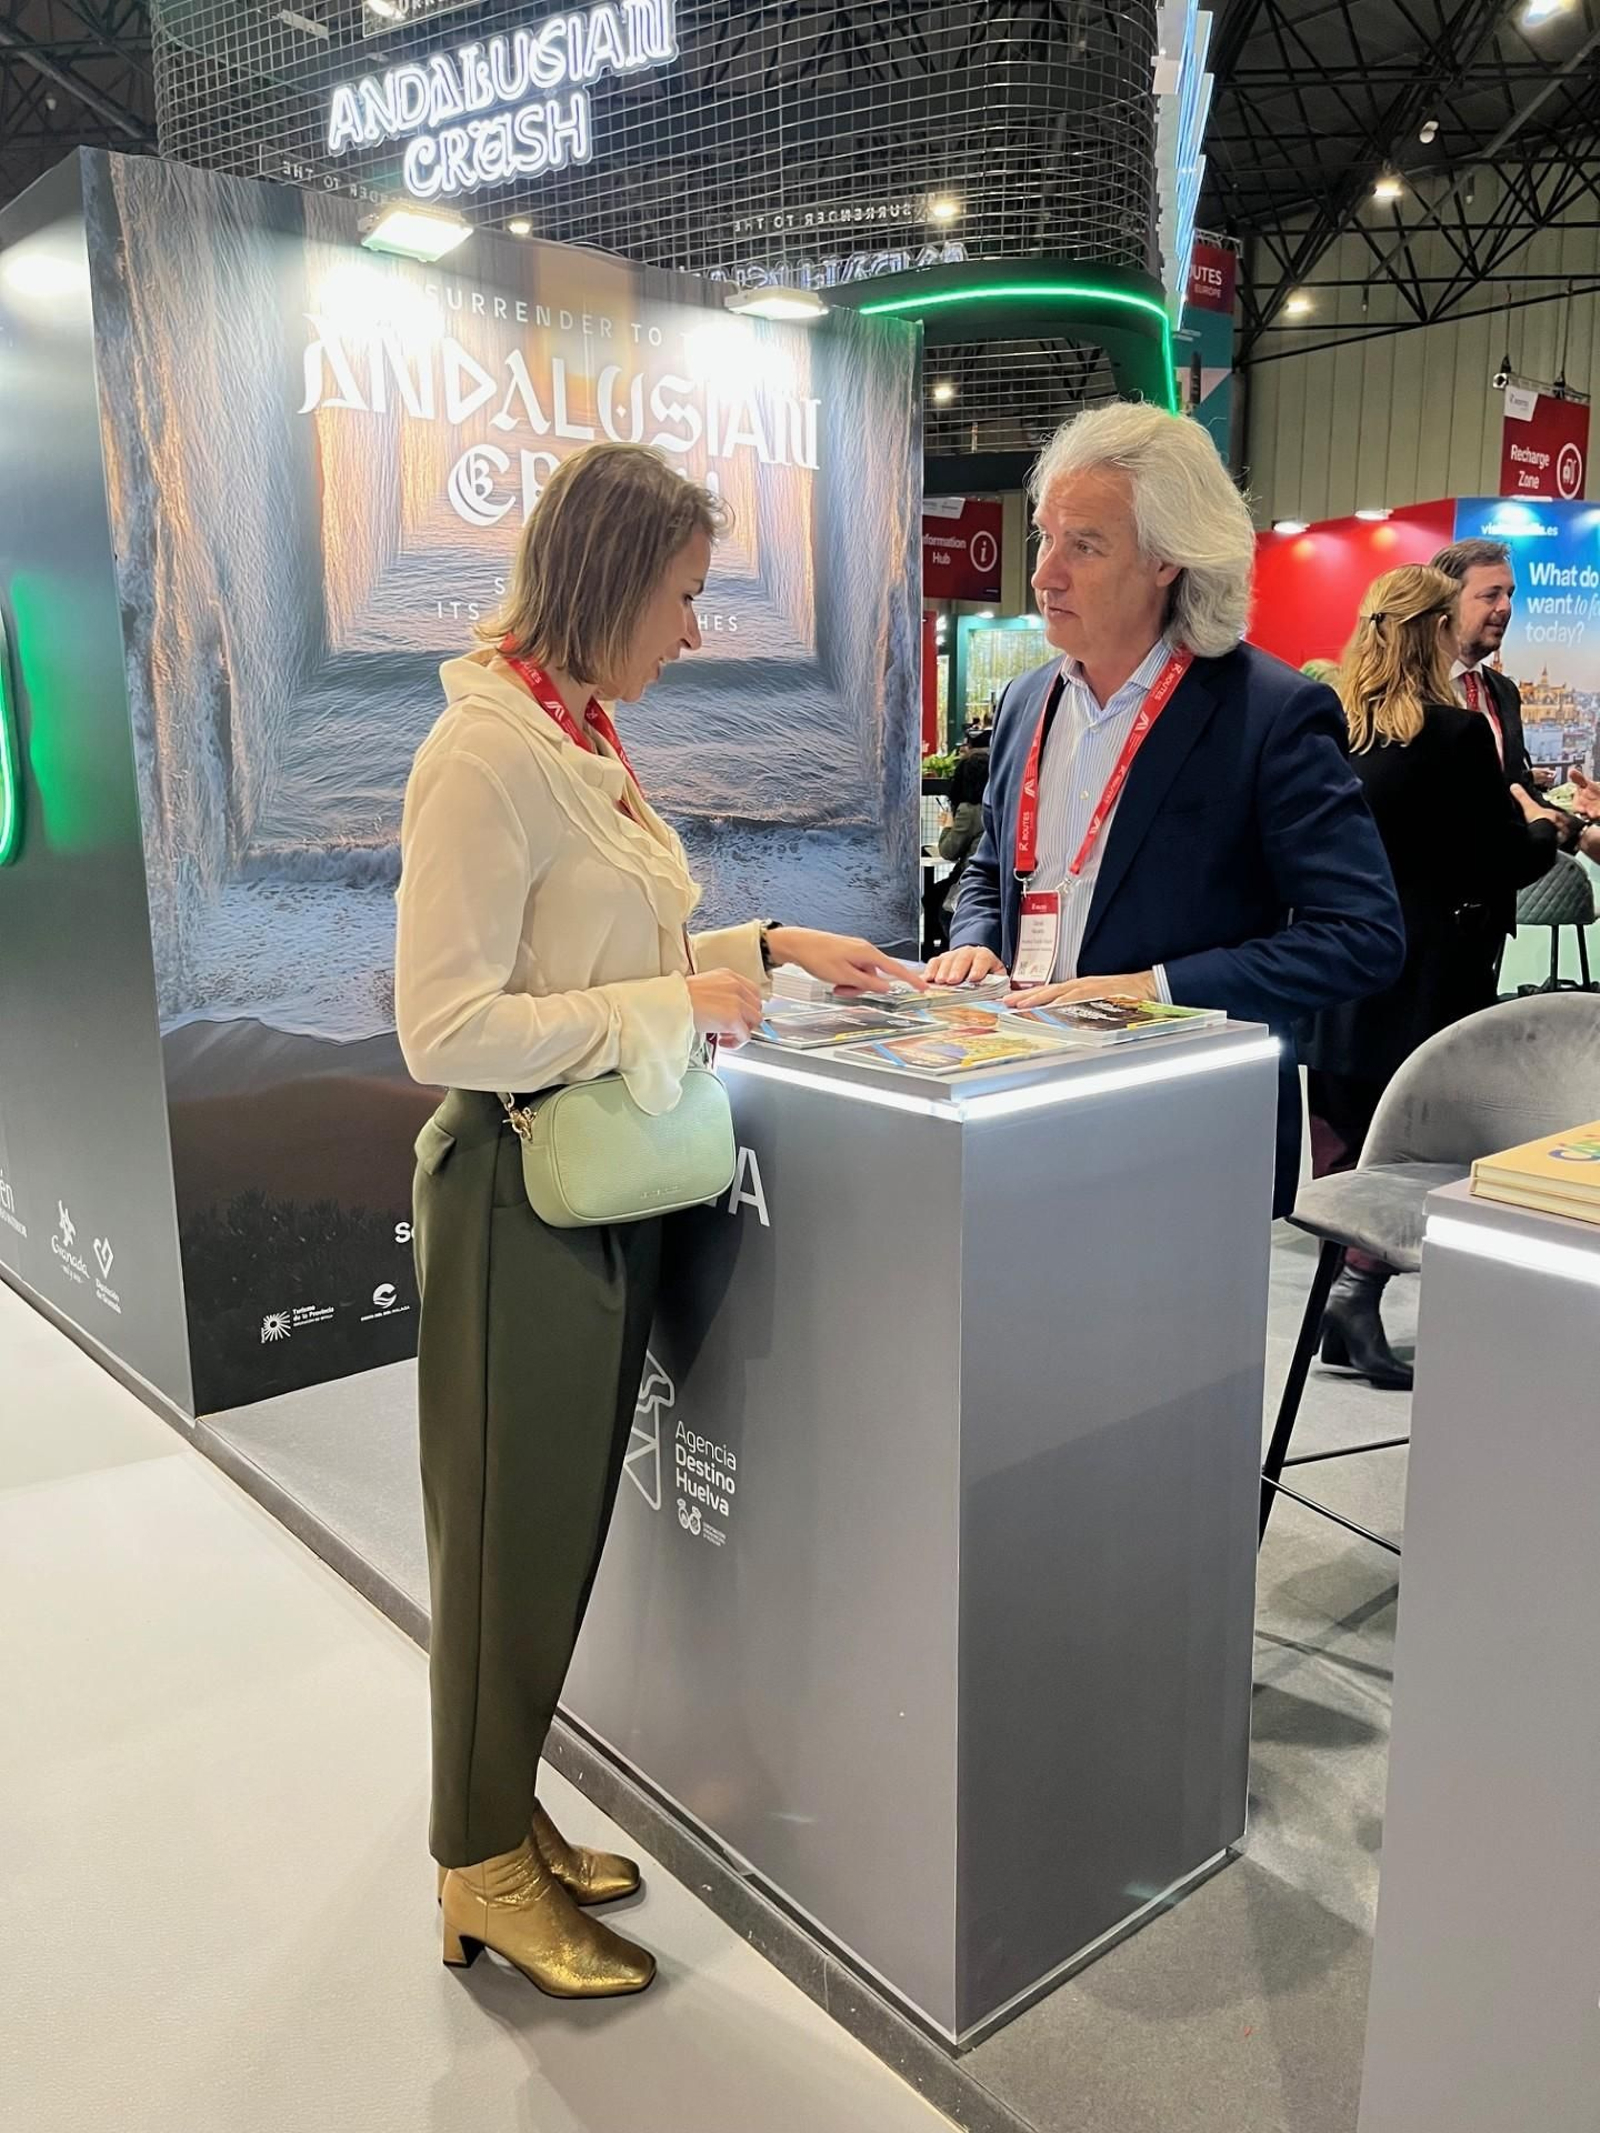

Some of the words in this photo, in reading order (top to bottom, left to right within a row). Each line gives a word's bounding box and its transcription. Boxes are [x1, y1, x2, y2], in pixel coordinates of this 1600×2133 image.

[328, 0, 677, 152] ANDALUSIAN
[404, 92, 592, 198] CRUSH
[425, 284, 613, 338] SURRENDER
[631, 322, 663, 347] TO
[298, 313, 823, 470] ANDALUSIAN
[1510, 444, 1550, 469] Recharge
[1518, 470, 1540, 489] Zone
[932, 551, 951, 565] Hub
[1529, 561, 1578, 587] What
[1579, 565, 1600, 588] do
[437, 601, 480, 621] ITS
[1526, 593, 1573, 615] want
[1525, 620, 1585, 646] today?
[1021, 811, 1031, 840] ROUTES
[675, 1420, 737, 1471] Agencia
[675, 1443, 736, 1495] Destino
[675, 1467, 730, 1517] Huelva
